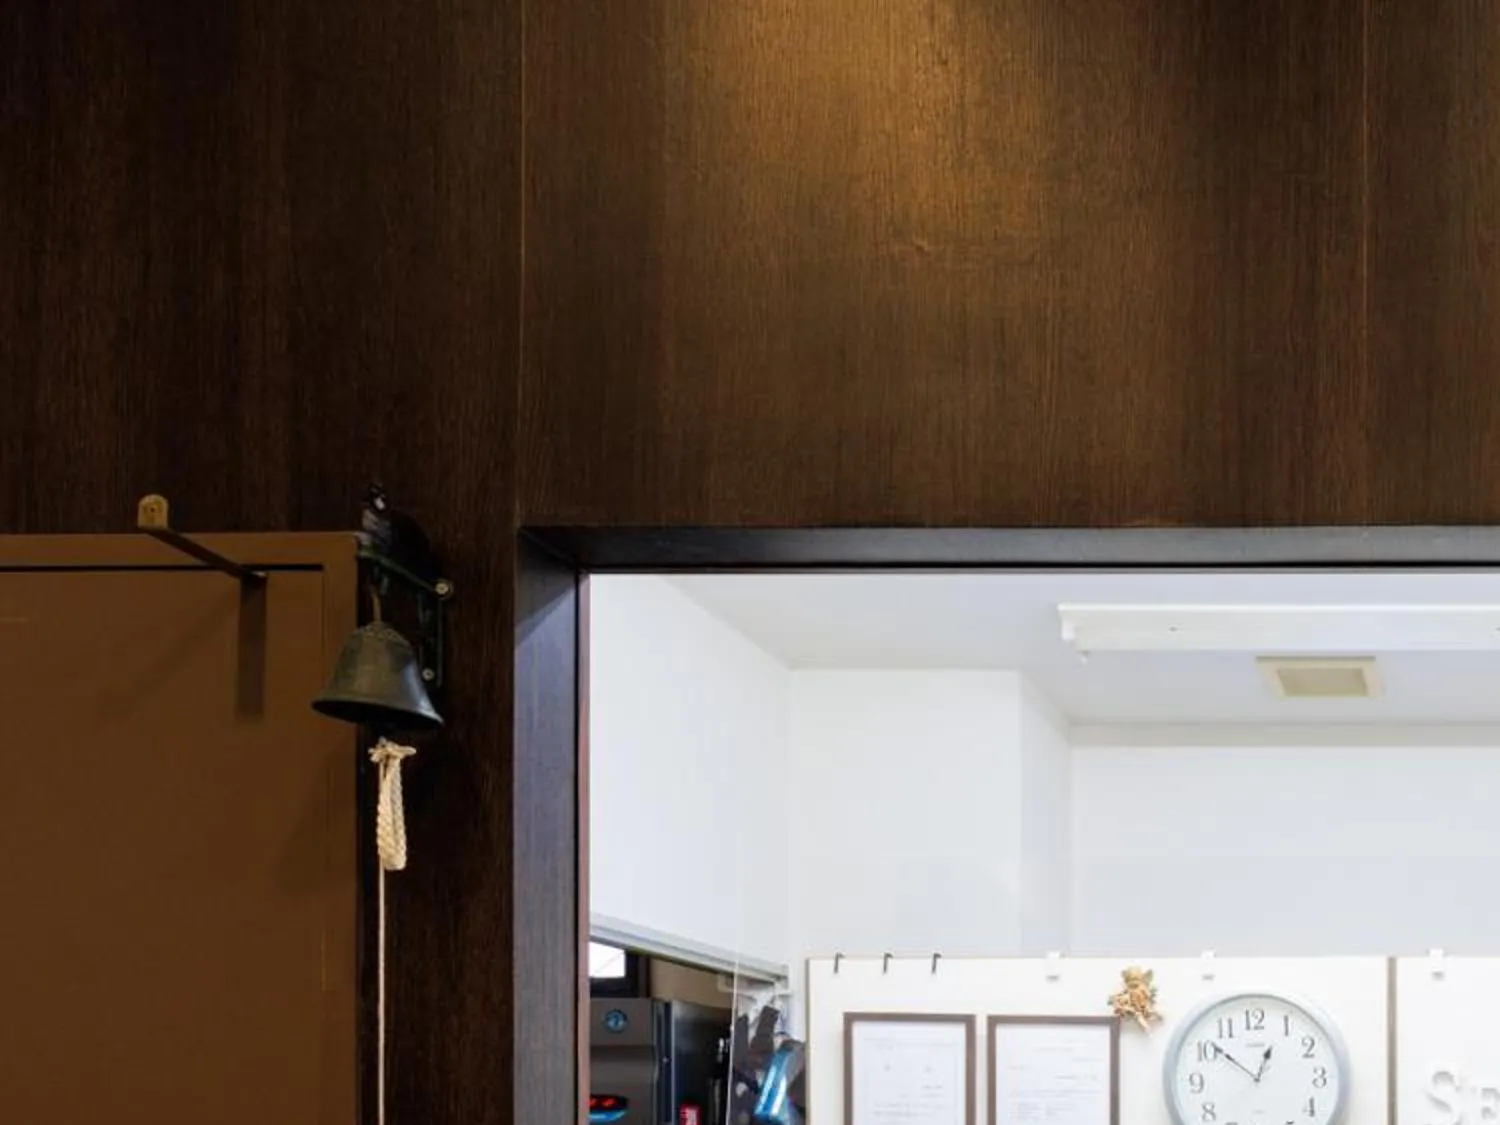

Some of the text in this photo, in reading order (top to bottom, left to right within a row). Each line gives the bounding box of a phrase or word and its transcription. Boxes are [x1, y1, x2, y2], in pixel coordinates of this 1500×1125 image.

[1217, 1017, 1233, 1039] 11
[1245, 1008, 1265, 1031] 12
[1282, 1014, 1289, 1036] 1
[1197, 1040, 1217, 1061] 10
[1302, 1036, 1316, 1058] 2
[1189, 1072, 1205, 1094] 9
[1312, 1066, 1327, 1089] 3
[1202, 1102, 1217, 1122] 8
[1303, 1097, 1315, 1118] 4
